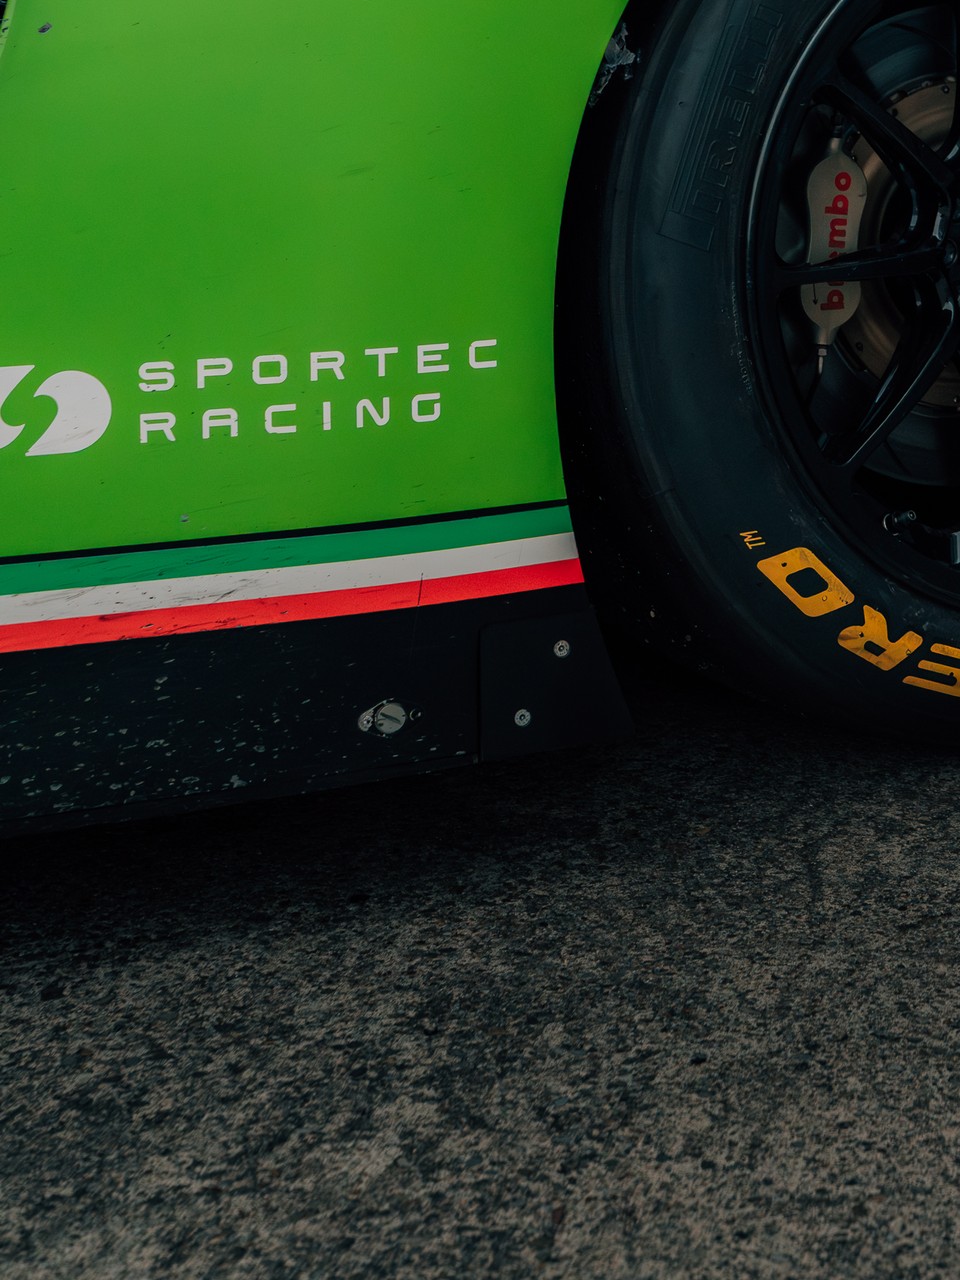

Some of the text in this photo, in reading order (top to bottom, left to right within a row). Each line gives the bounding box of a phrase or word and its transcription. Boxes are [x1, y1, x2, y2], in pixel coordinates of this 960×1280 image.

[820, 171, 852, 311] bmbo
[138, 339, 497, 392] SPORTEC
[139, 392, 441, 444] RACING
